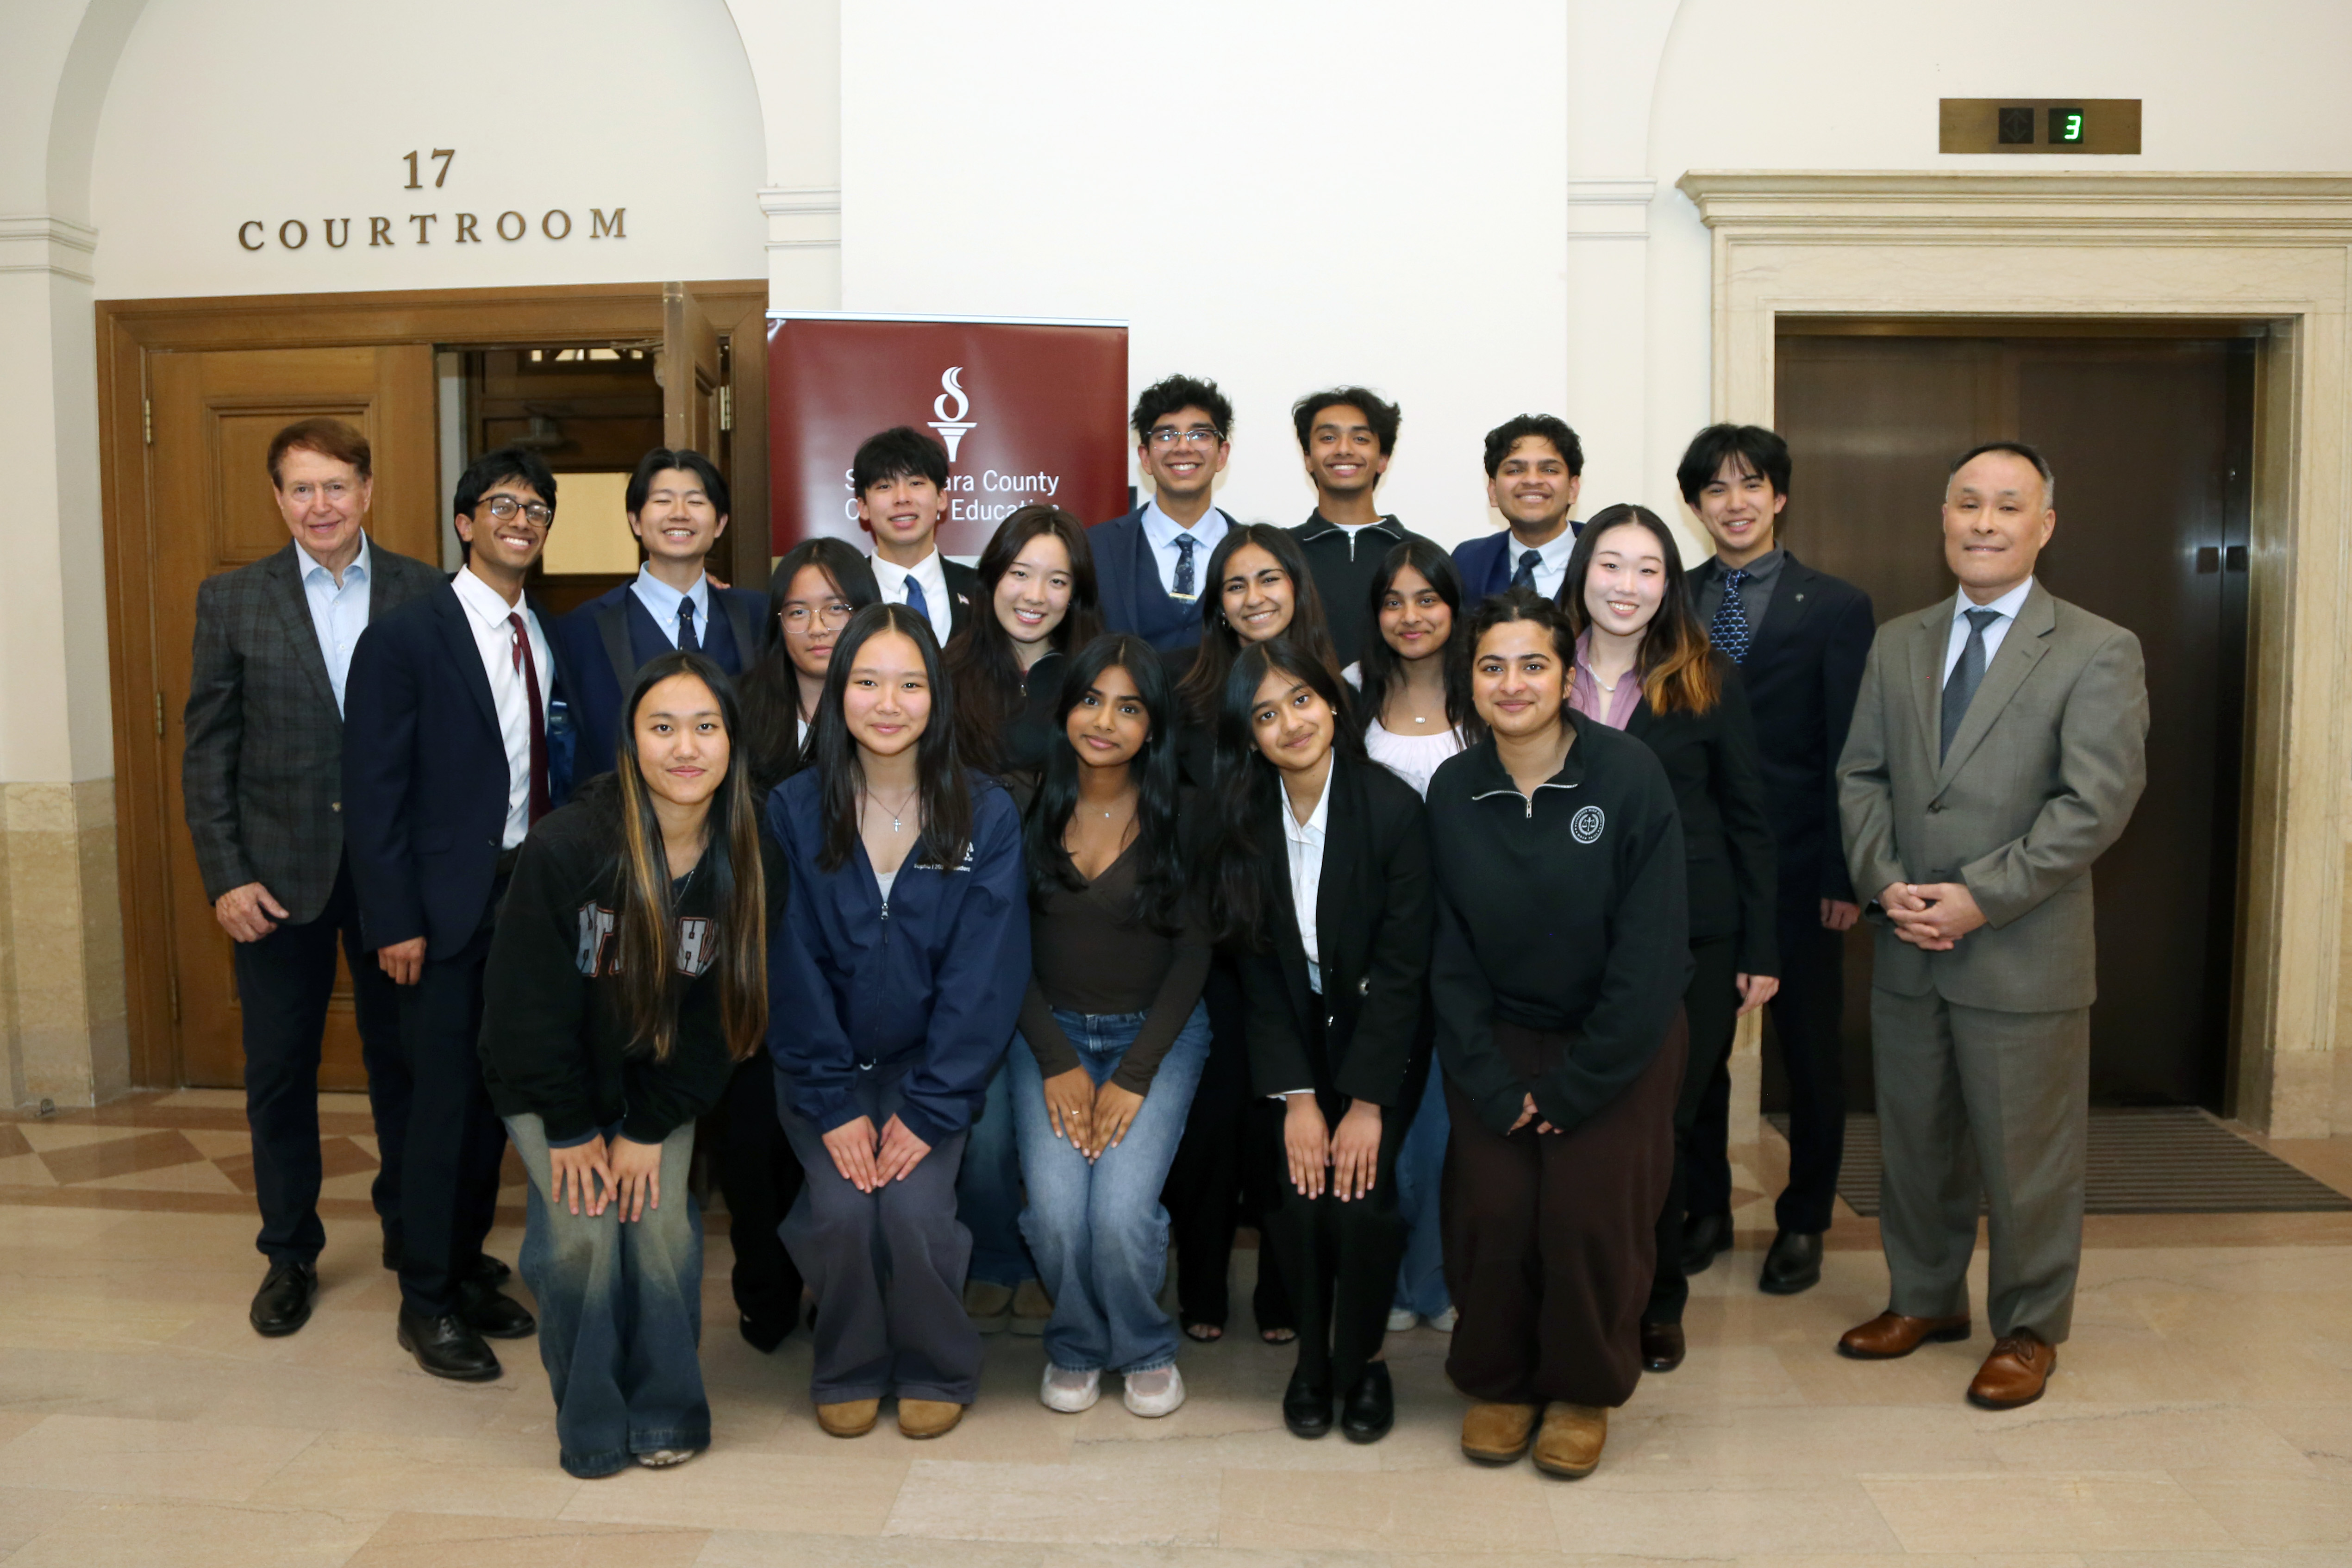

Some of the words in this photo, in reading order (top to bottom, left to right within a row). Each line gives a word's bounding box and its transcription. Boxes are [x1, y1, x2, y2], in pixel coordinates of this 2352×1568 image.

[2064, 115, 2081, 139] 3
[402, 148, 455, 189] 17
[238, 207, 626, 250] COURTROOM
[945, 476, 975, 491] ara
[982, 469, 1059, 496] County
[951, 499, 1059, 520] Educa
